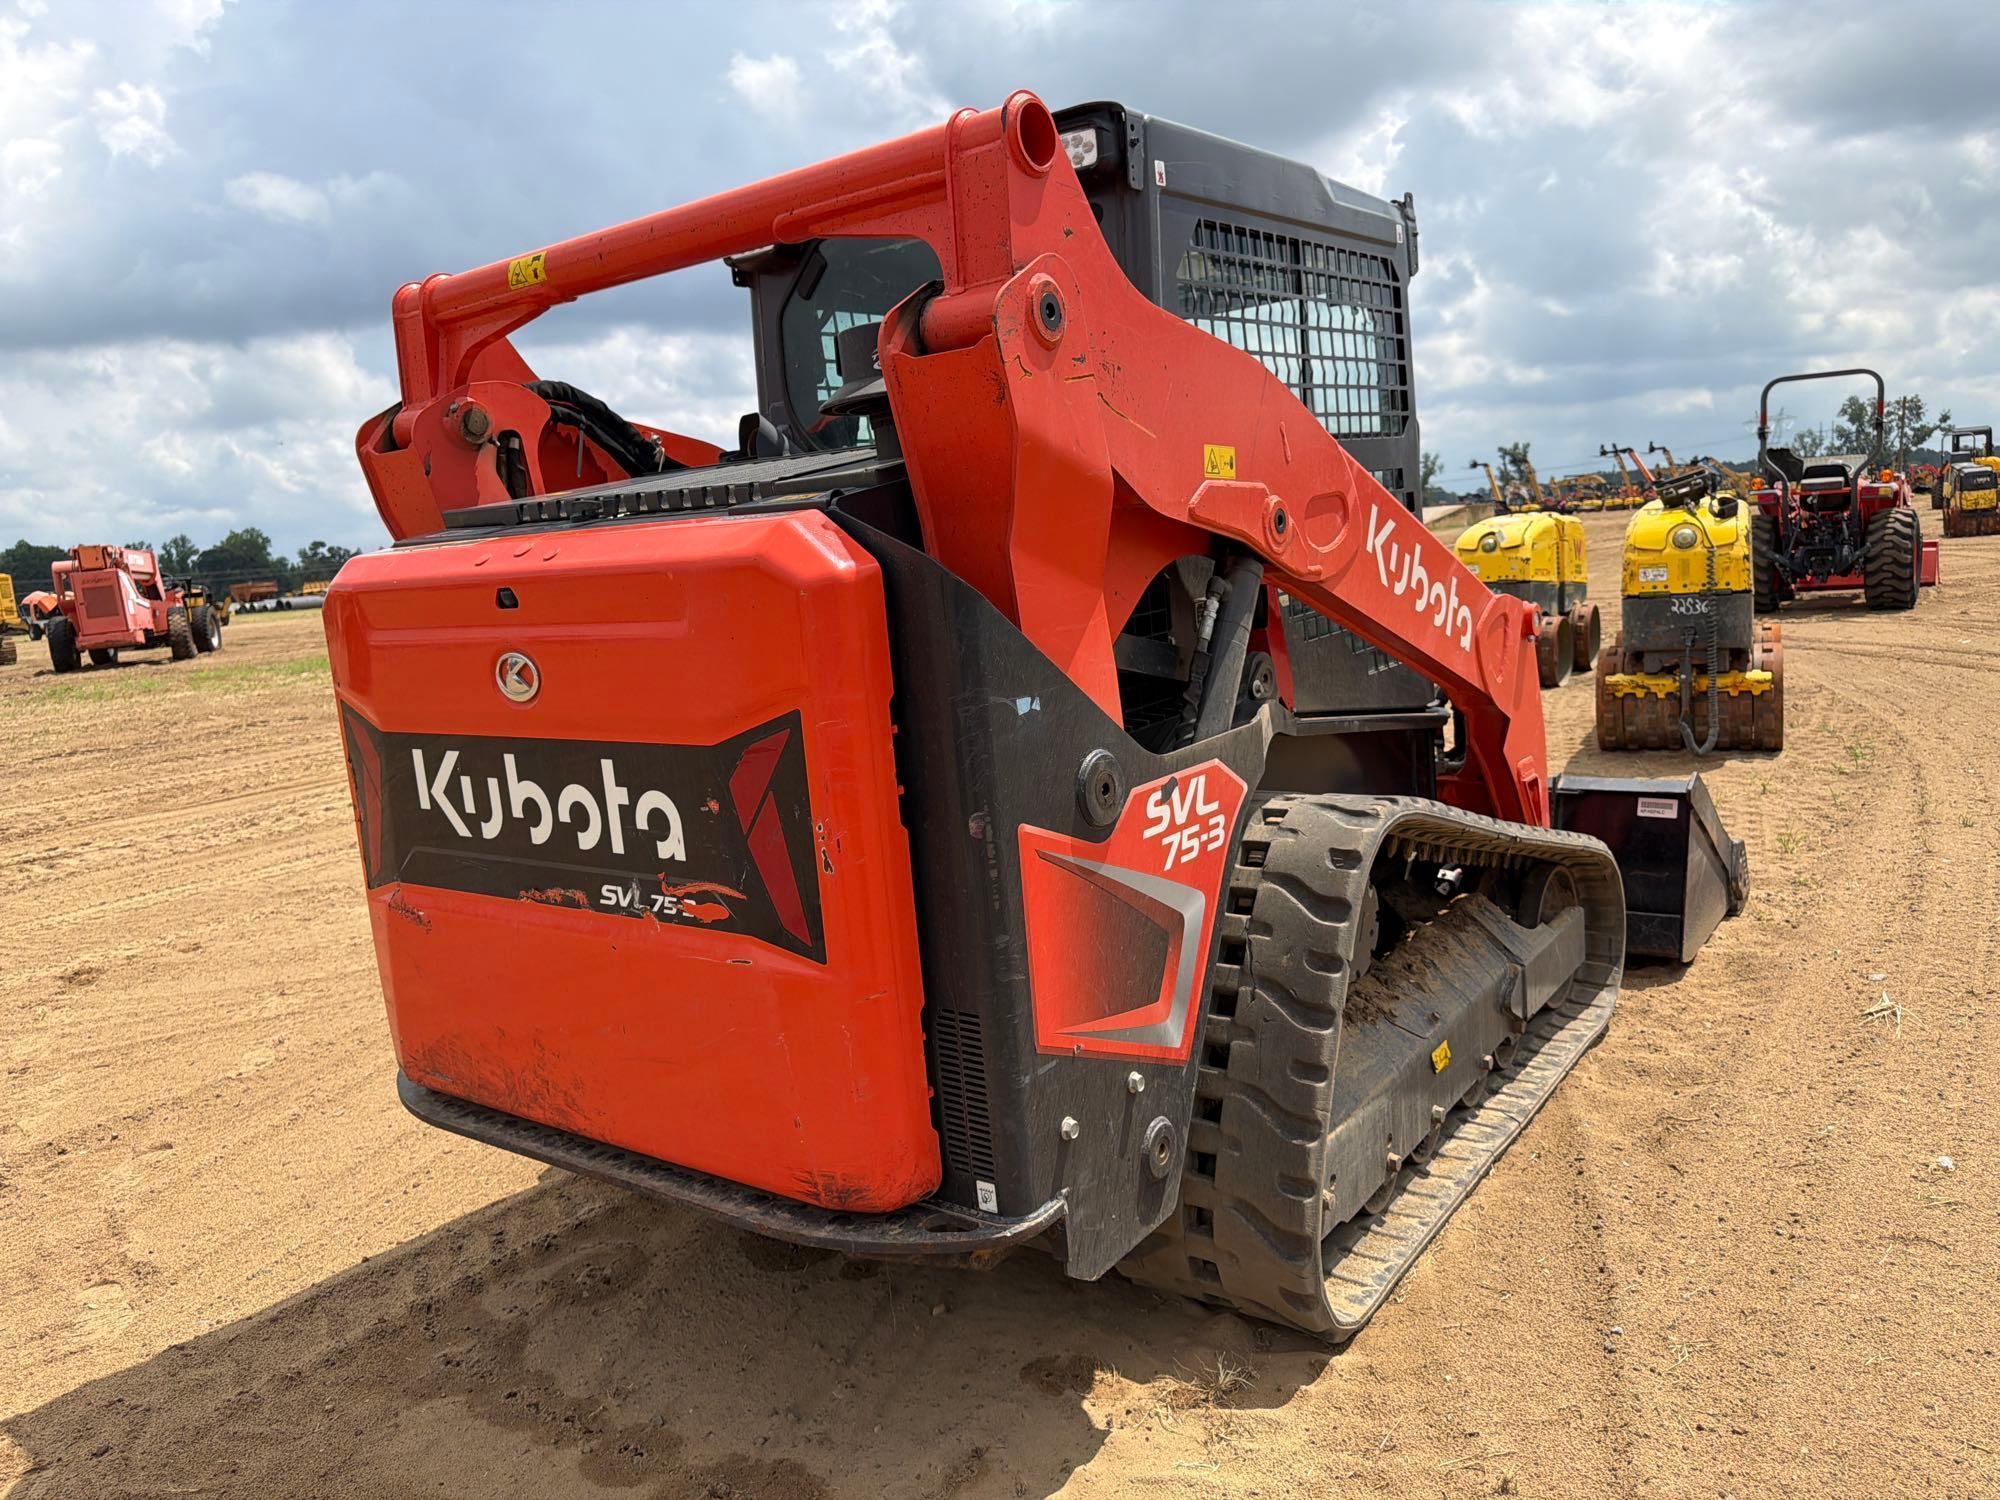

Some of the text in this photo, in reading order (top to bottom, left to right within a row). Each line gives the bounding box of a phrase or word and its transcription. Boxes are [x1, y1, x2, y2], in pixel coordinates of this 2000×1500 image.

[1366, 503, 1473, 653] Kubota
[411, 747, 687, 862] Kubota
[1142, 774, 1219, 840] SVL
[1161, 813, 1226, 871] 75-3
